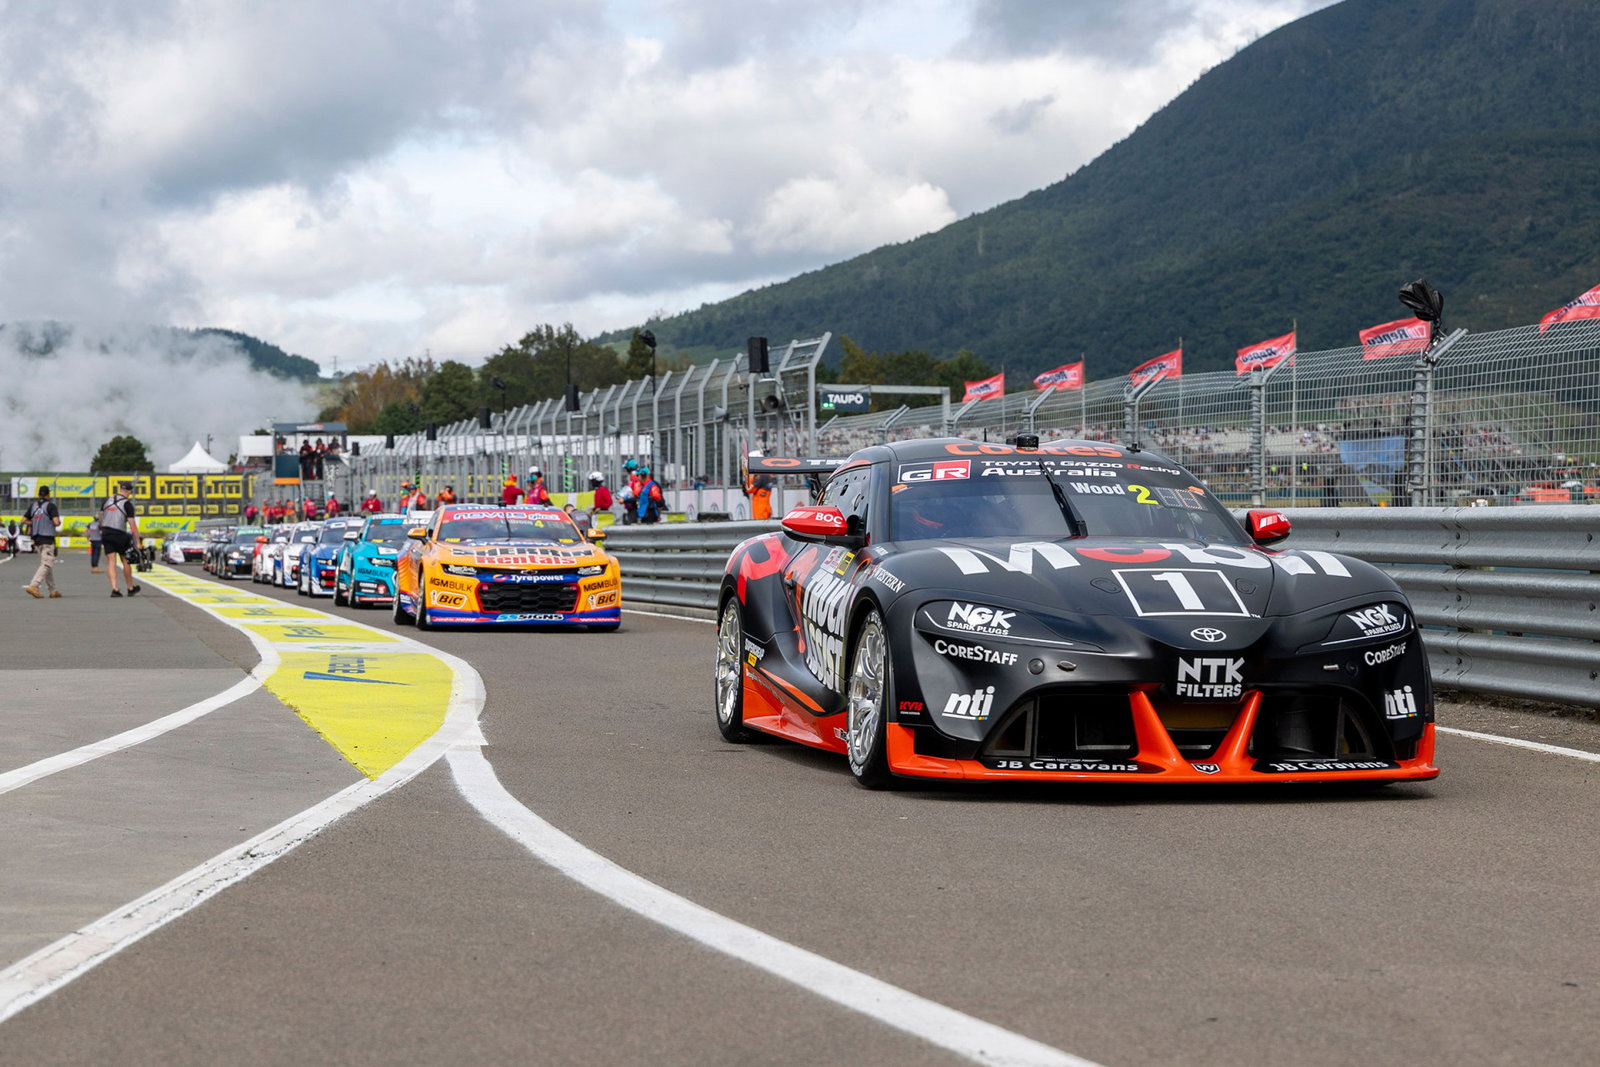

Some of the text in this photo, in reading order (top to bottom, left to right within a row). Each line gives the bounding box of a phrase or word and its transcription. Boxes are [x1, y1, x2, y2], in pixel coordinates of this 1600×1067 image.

[901, 467, 967, 482] GR
[981, 467, 1117, 478] Australia
[1060, 460, 1123, 468] GAZOO
[1126, 463, 1181, 475] Racing
[1070, 482, 1159, 505] Wood 2
[815, 512, 844, 525] BOC
[511, 574, 563, 583] Tyrepower
[1151, 571, 1206, 610] 1
[947, 601, 1017, 629] NGK
[1346, 603, 1398, 630] NGK
[946, 620, 1009, 635] SPARK PLUGS
[1383, 622, 1401, 633] PLUGS
[1177, 656, 1245, 683] NTK
[1176, 683, 1242, 698] FILTERS
[943, 685, 996, 716] nti
[1384, 685, 1417, 716] nti
[997, 760, 1139, 771] JB Caravans
[1269, 760, 1390, 771] JB Caravans
